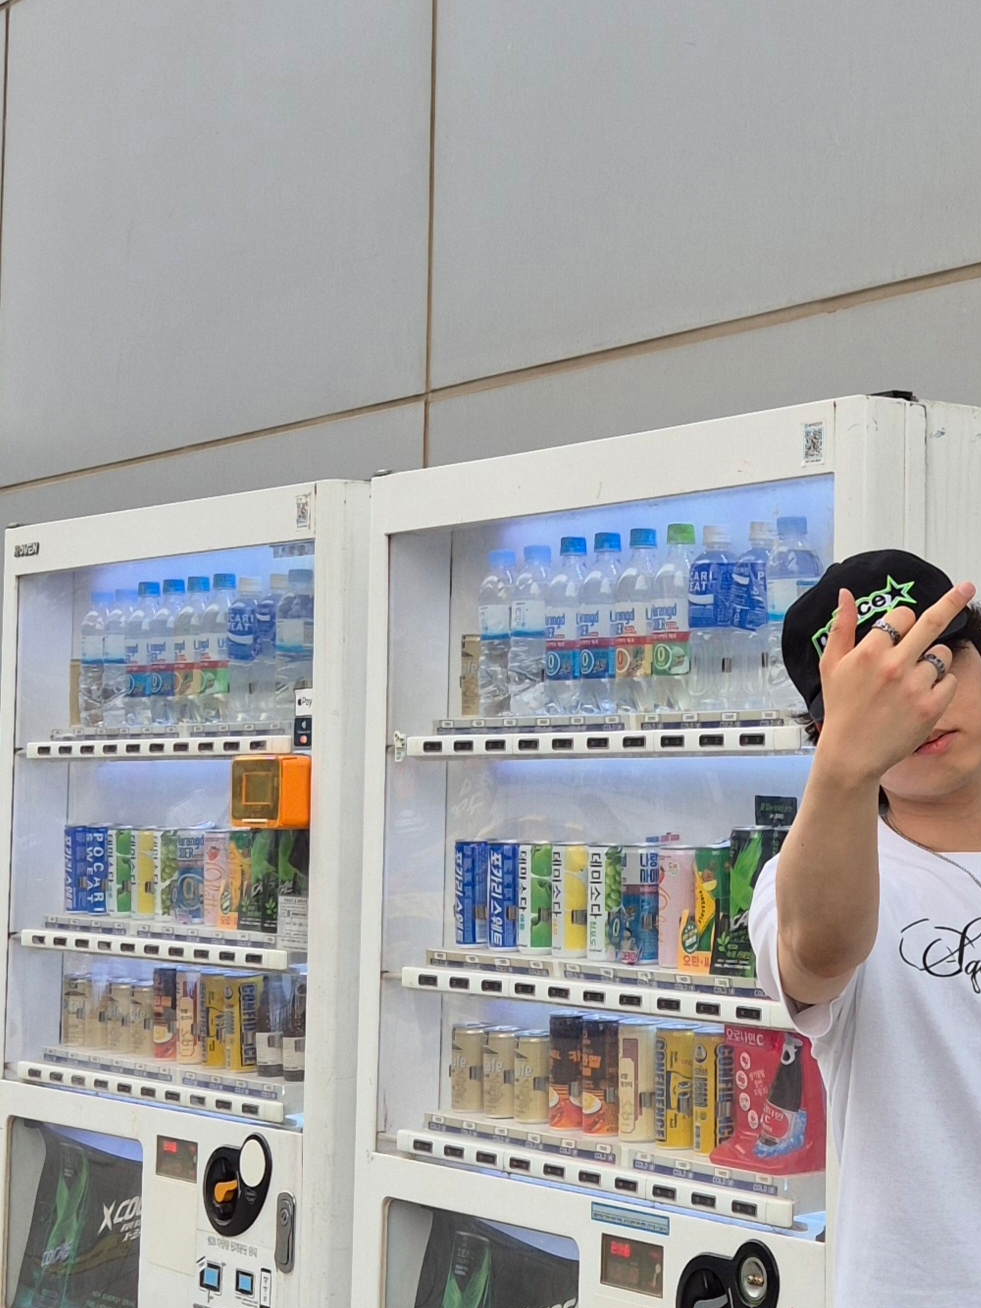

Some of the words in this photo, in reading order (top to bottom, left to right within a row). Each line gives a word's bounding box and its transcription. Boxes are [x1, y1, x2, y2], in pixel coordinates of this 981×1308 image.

[86, 832, 94, 904] SWEAT
[93, 832, 105, 912] POCARI
[518, 850, 527, 911] 데미소다
[552, 851, 562, 916] 데미소다
[590, 852, 603, 917] 데미소다
[640, 852, 659, 868] 나랑
[490, 850, 503, 946] 포카리스웨트
[241, 984, 257, 1065] CONFIDCE
[726, 1027, 764, 1046] 오로나민C
[718, 1044, 734, 1144] CONFIDNC
